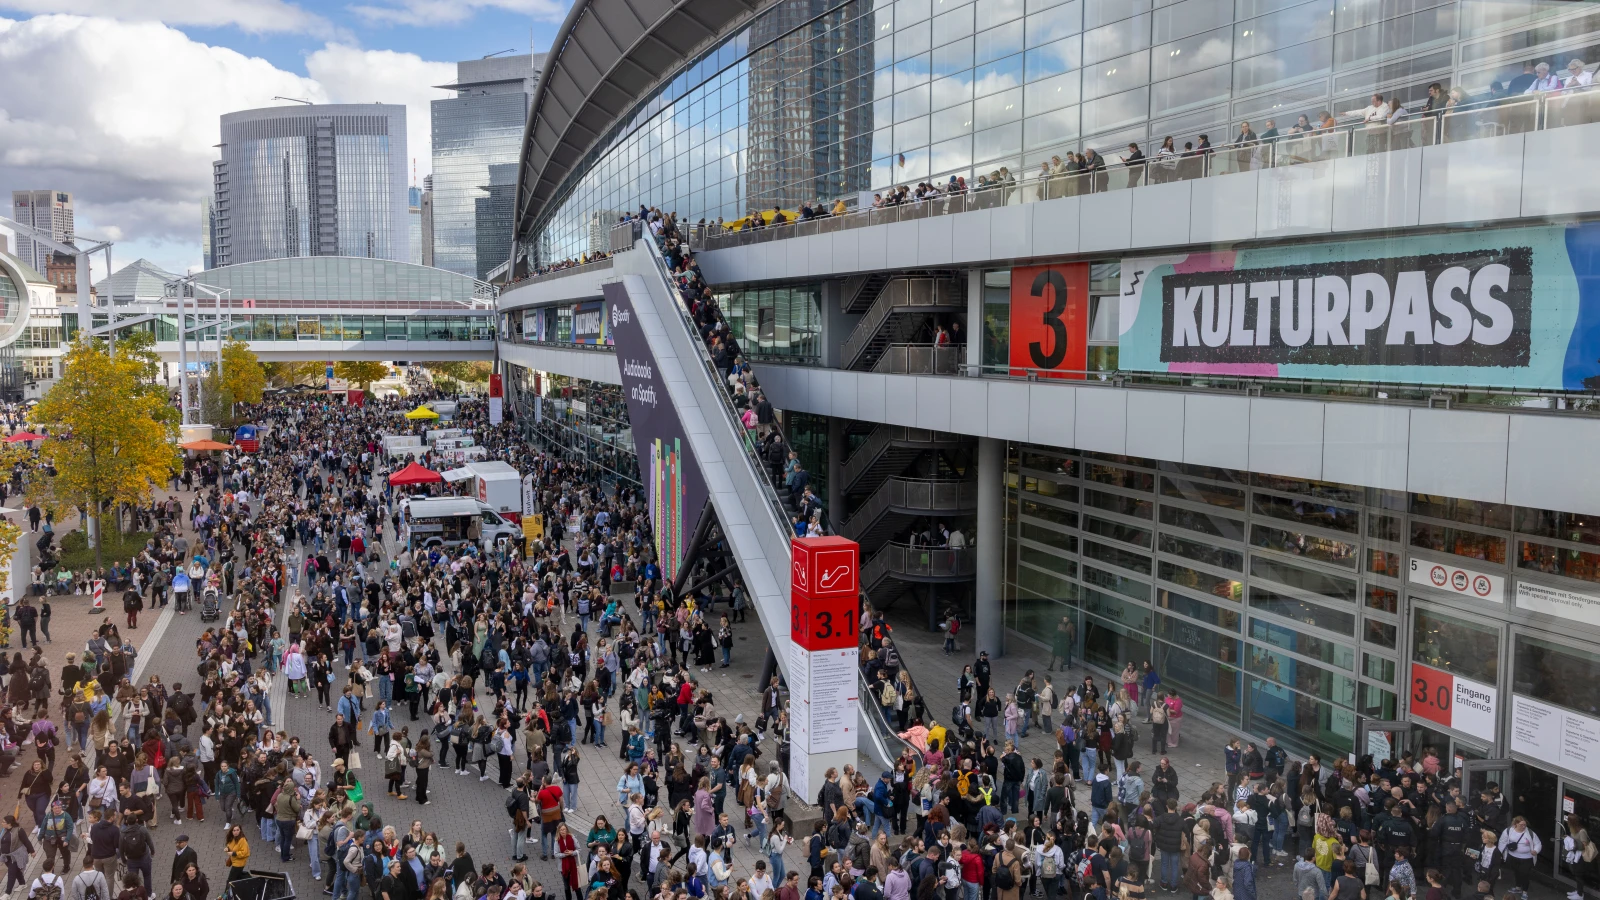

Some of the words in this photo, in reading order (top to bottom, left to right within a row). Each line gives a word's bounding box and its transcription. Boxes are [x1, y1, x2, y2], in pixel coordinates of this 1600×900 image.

[247, 300, 252, 308] 1
[1172, 264, 1511, 348] KULTURPASS
[617, 309, 630, 323] Spotify
[1029, 270, 1068, 369] 3
[624, 359, 652, 379] Audiobooks
[632, 386, 638, 400] on
[639, 384, 657, 408] Spotify.
[1411, 560, 1418, 571] 5
[1531, 593, 1548, 601] special
[1549, 597, 1571, 606] approval
[1571, 601, 1584, 609] only.
[792, 605, 808, 638] 3.1
[816, 610, 853, 639] 3.1
[1414, 678, 1450, 711] 3.0
[1456, 683, 1490, 703] Eingang
[1456, 694, 1491, 713] Entrance
